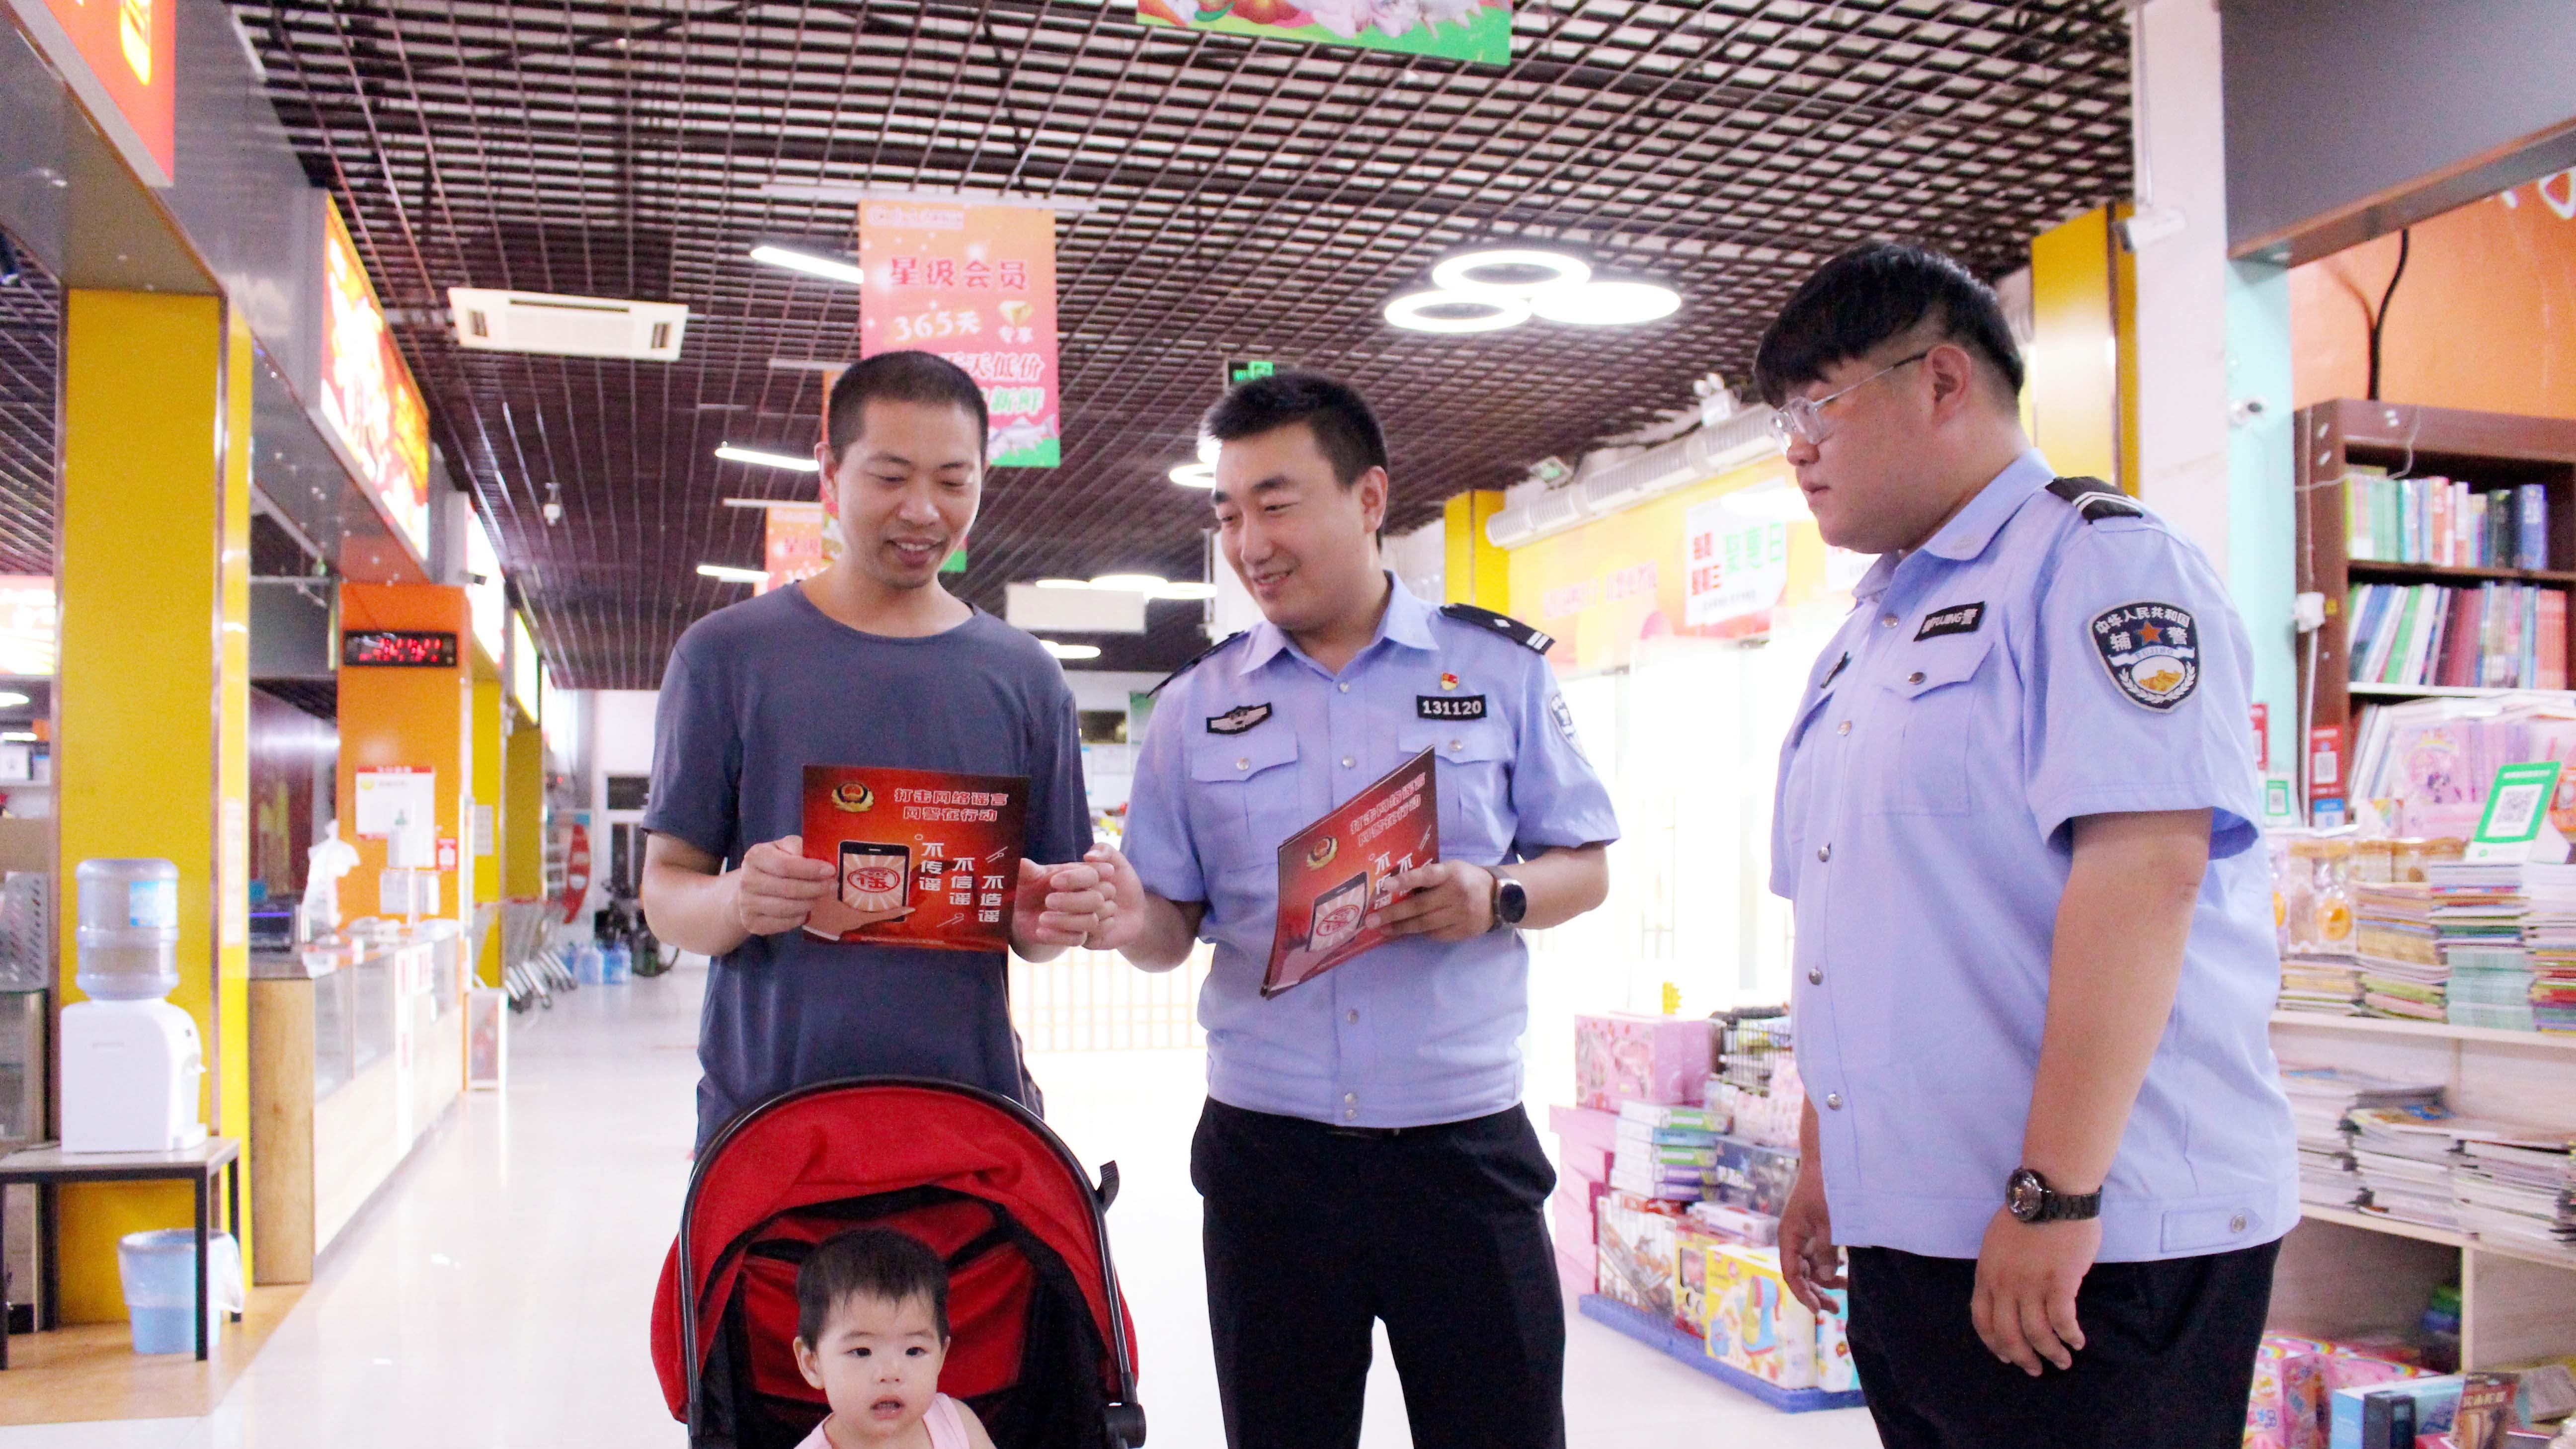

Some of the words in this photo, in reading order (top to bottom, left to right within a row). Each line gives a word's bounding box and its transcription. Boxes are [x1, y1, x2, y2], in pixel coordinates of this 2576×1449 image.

[890, 256, 1028, 291] 星级会员
[1423, 700, 1482, 715] 131120
[894, 787, 1009, 806] 打击网络谣言
[903, 806, 998, 822] 网警在行动
[919, 842, 944, 891] 不传谣
[949, 857, 975, 905] 不信谣
[978, 875, 1004, 923] 不造谣
